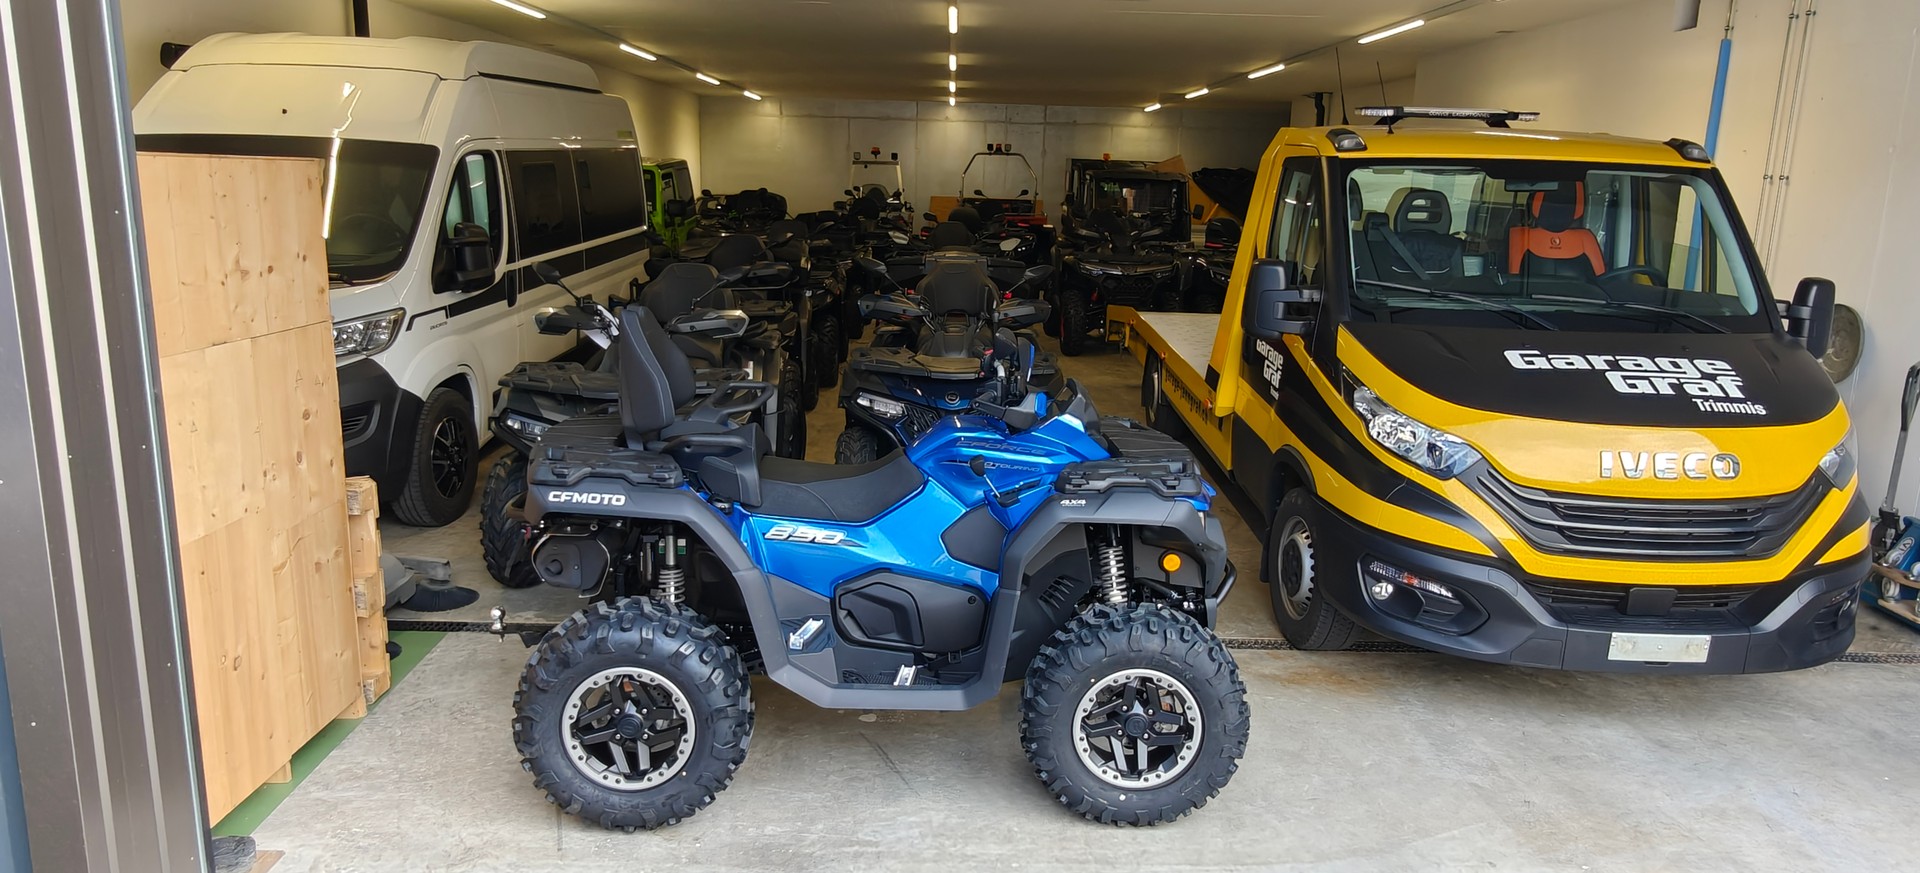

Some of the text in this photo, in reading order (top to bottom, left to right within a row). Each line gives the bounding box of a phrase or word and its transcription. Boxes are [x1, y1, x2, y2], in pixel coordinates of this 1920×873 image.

[1263, 359, 1282, 389] Graf
[1503, 349, 1737, 378] Garage
[1604, 371, 1746, 399] Graf
[1692, 398, 1767, 416] Trimmis
[1600, 450, 1741, 480] IVECO
[548, 490, 626, 506] CFMOTO
[764, 524, 847, 545] 850
